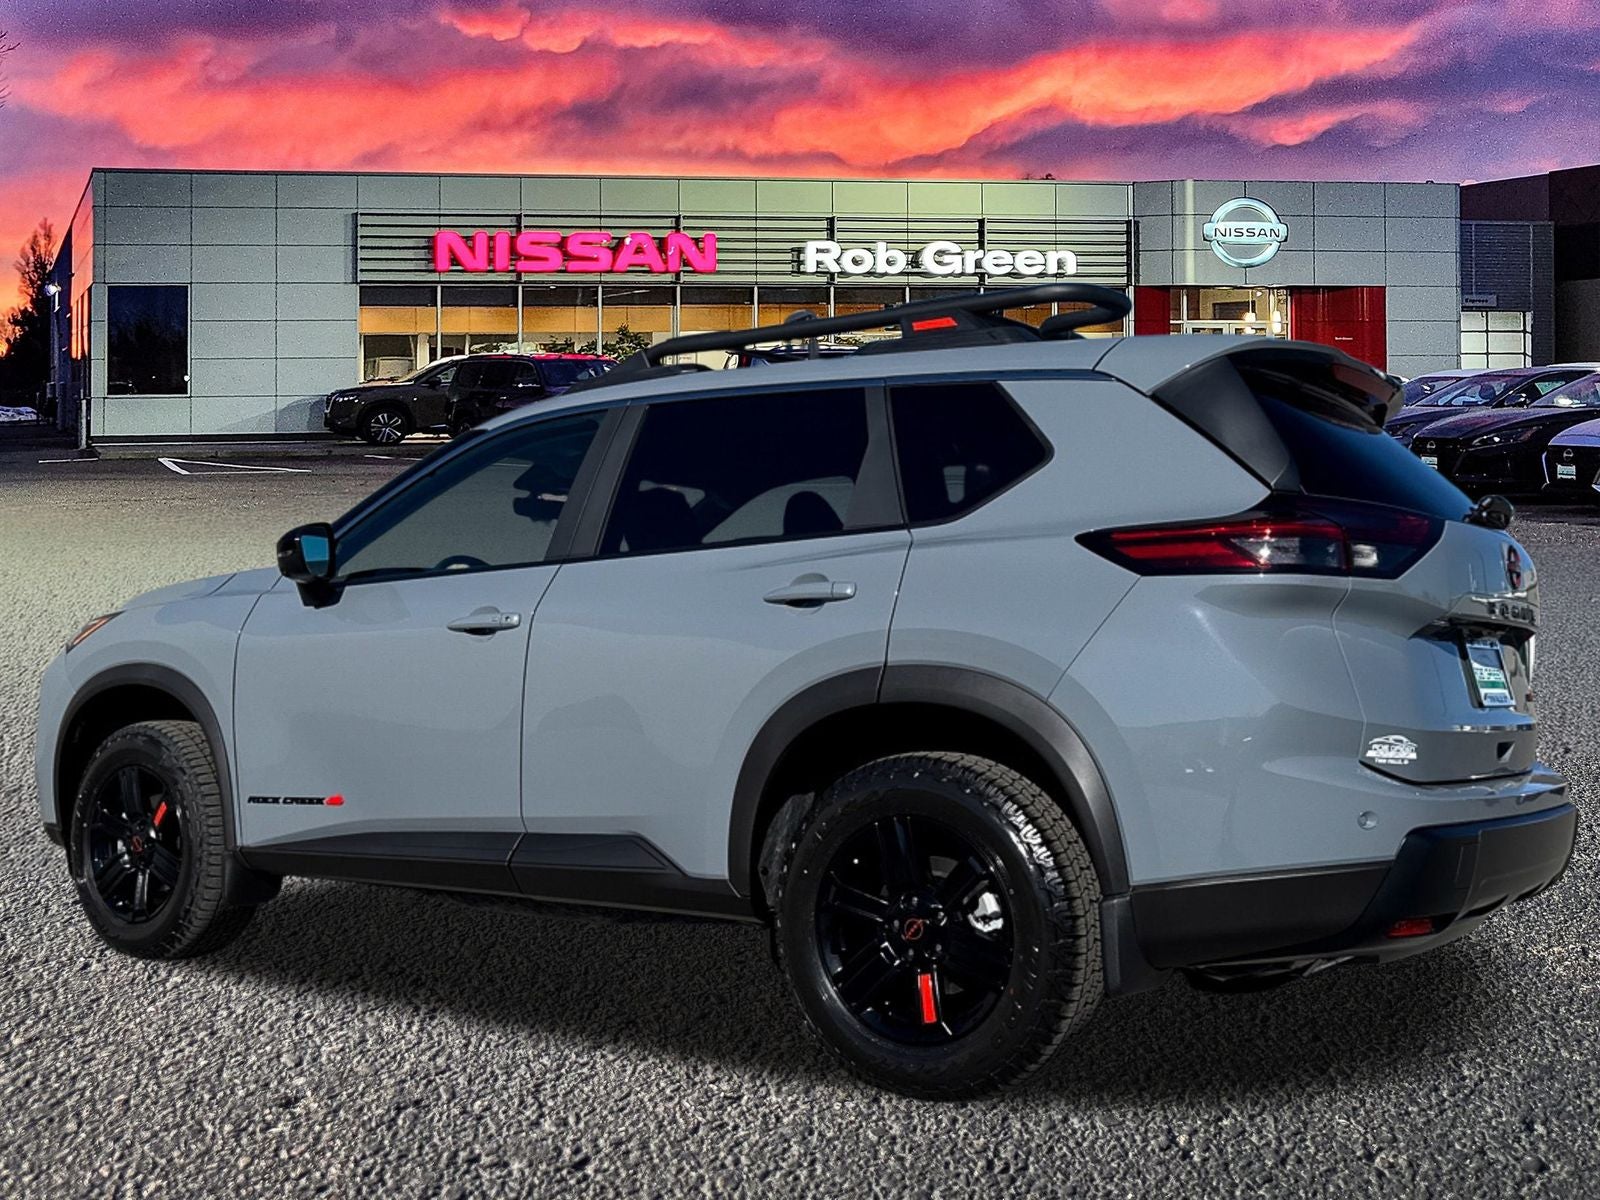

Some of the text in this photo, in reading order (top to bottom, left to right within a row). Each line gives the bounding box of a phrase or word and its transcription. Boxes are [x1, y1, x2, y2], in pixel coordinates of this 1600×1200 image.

[1214, 227, 1280, 238] NISSAN
[434, 231, 718, 273] NISSAN
[804, 240, 1078, 275] Rob Green
